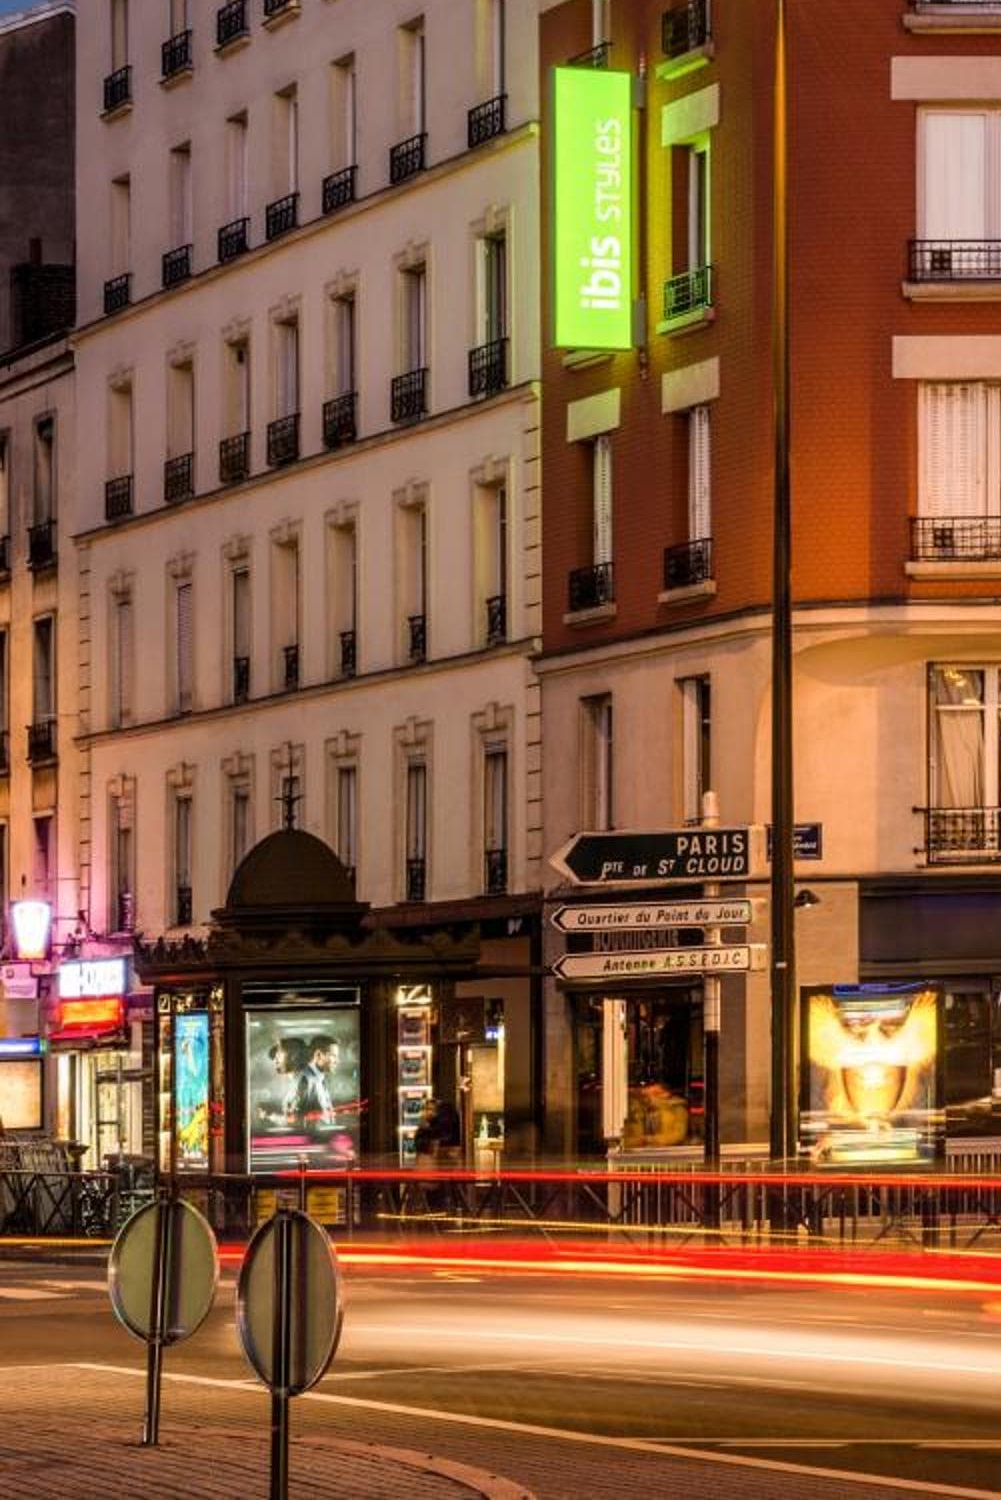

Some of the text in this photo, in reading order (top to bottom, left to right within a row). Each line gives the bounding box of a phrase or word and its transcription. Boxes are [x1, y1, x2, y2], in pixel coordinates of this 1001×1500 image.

[580, 235, 621, 309] ibis
[676, 834, 745, 856] PARIS
[686, 855, 745, 874] CLOUD
[578, 905, 744, 925] Quartier du Point du Jour
[603, 954, 656, 972] Antenne
